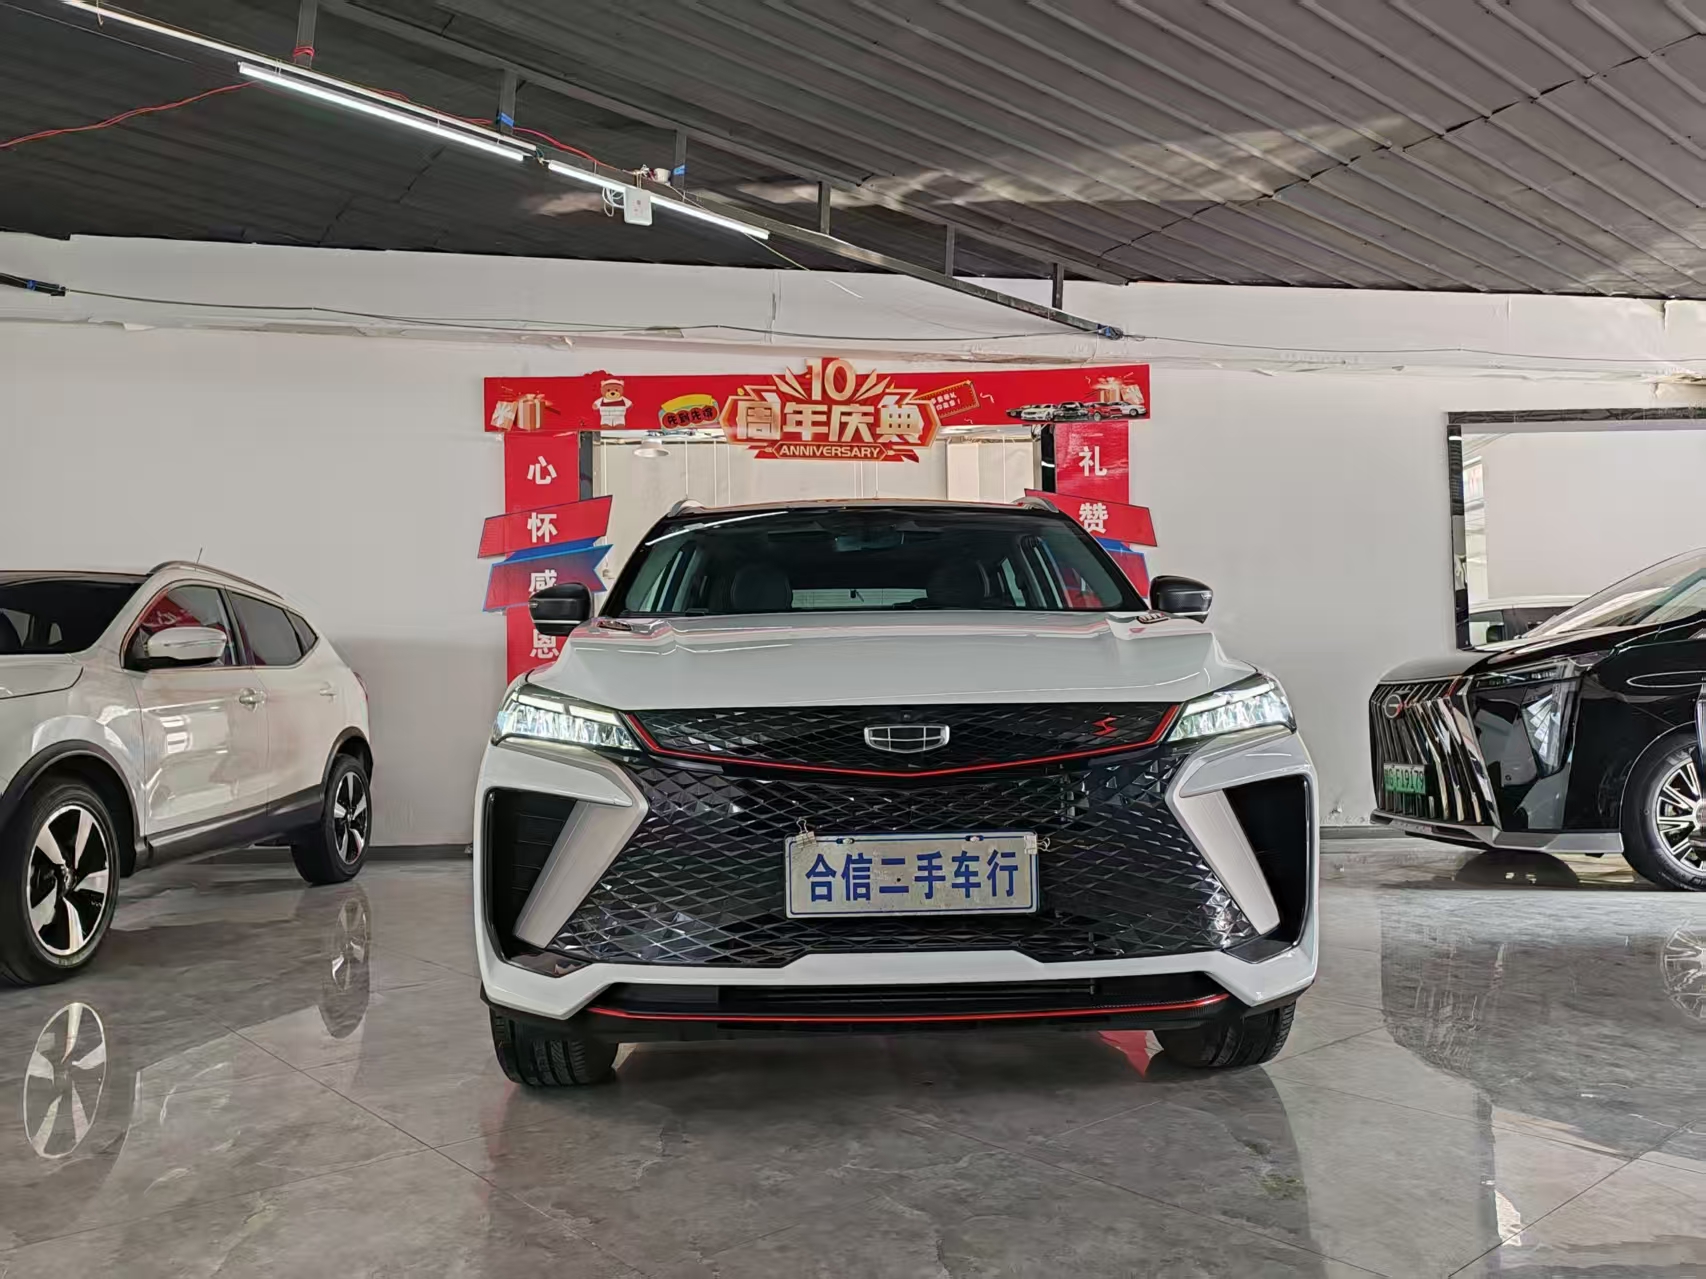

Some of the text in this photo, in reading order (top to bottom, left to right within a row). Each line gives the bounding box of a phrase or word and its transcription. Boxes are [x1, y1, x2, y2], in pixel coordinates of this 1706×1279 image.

[806, 359, 856, 400] 10
[736, 392, 924, 443] 周年庆典
[779, 445, 881, 458] ANNIVERSARY
[805, 850, 1019, 902] 合信二手车行
